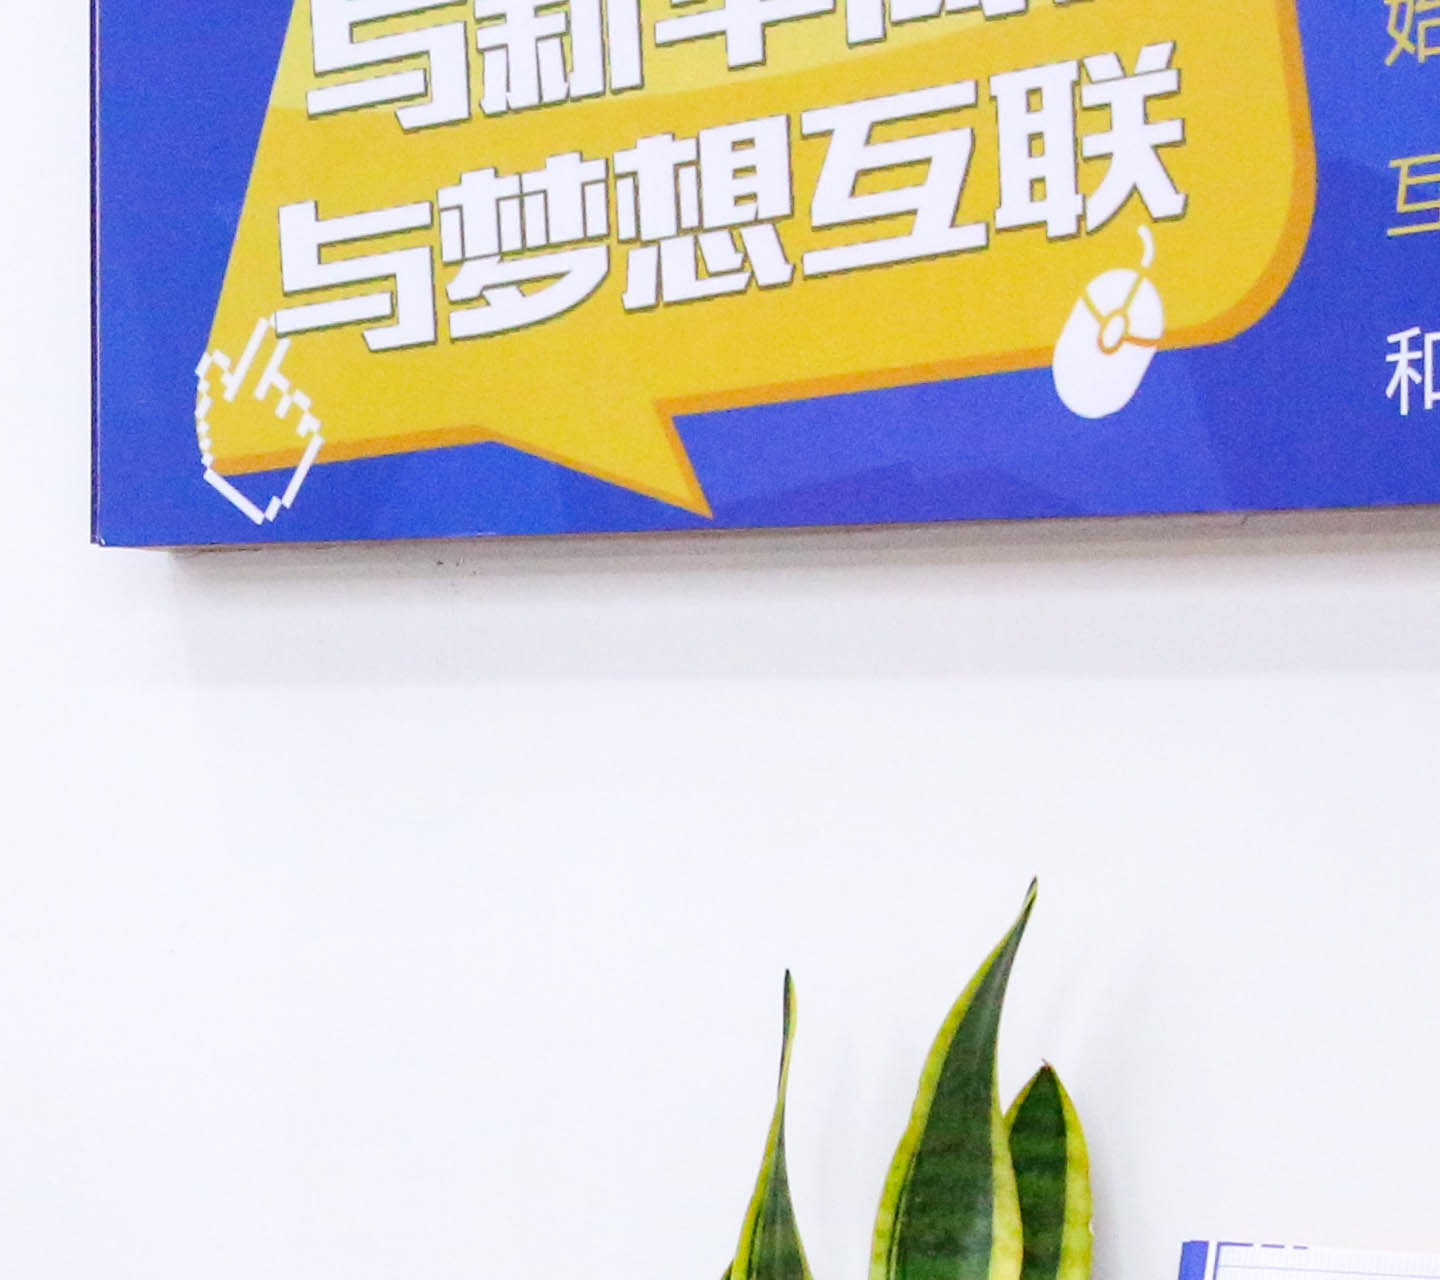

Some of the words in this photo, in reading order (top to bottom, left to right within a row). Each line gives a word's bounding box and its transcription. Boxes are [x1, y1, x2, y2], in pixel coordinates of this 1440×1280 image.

[276, 40, 1188, 353] 与梦想互联
